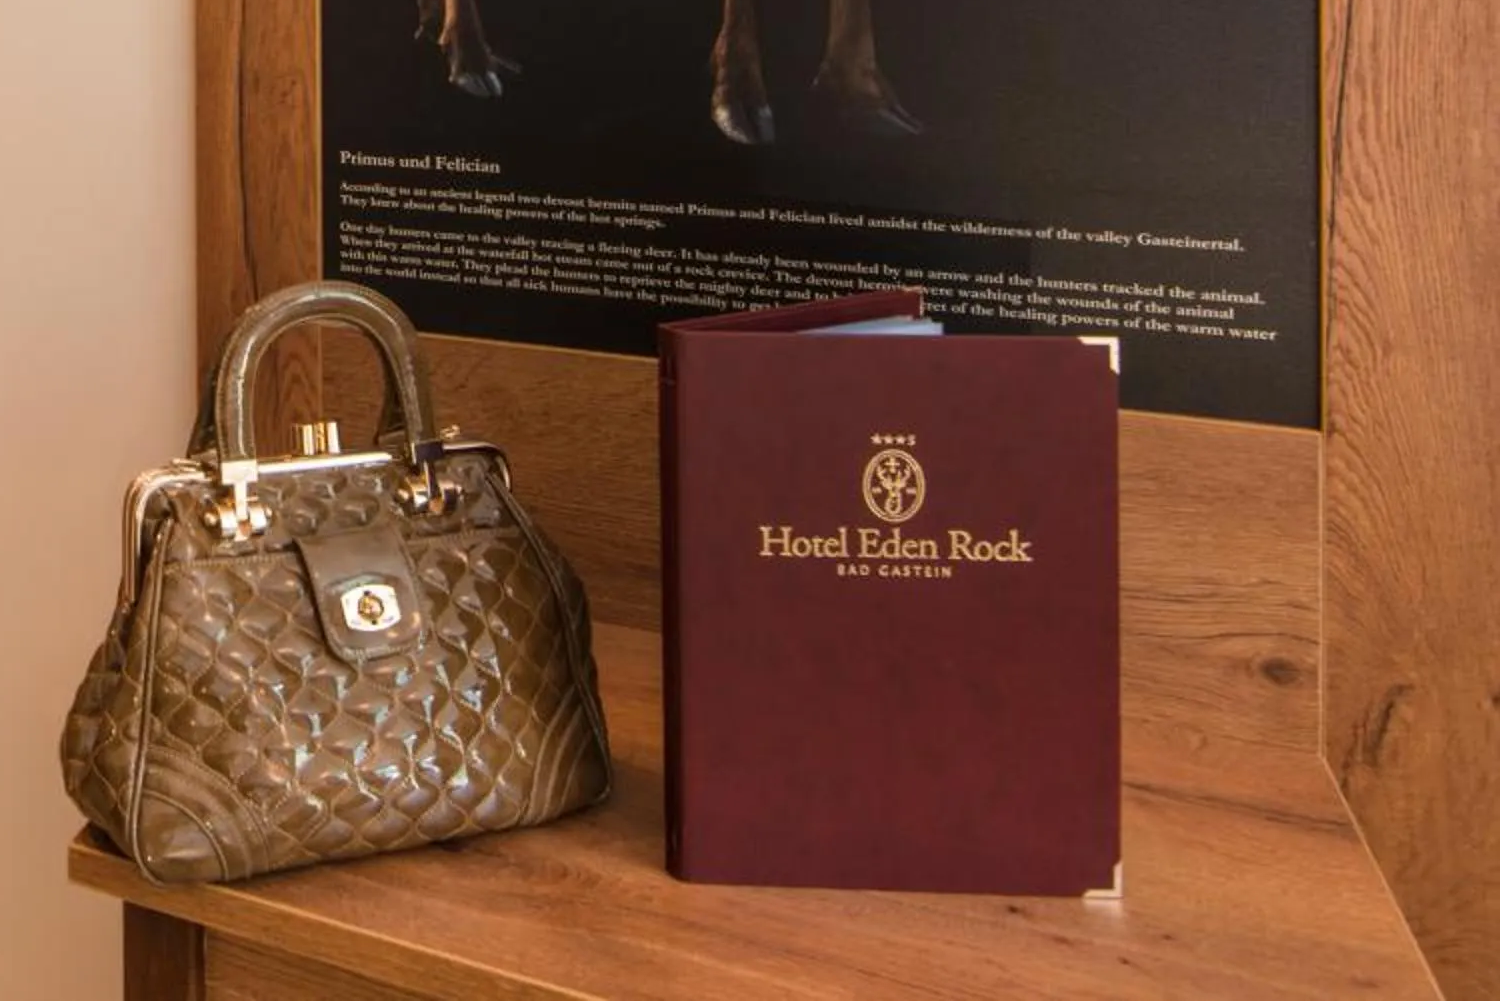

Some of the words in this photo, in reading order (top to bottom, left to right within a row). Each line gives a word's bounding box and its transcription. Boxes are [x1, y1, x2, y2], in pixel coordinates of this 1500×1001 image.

[340, 150, 395, 167] Primus
[399, 155, 430, 169] und
[435, 156, 500, 174] Felician
[340, 180, 396, 197] According
[398, 184, 410, 195] to
[413, 188, 427, 197] an
[429, 188, 472, 200] ancient
[474, 189, 515, 204] legend
[517, 192, 540, 205] two
[542, 194, 584, 208] devout
[587, 197, 636, 211] hermits
[639, 203, 684, 214] named
[688, 204, 736, 218] Primus
[739, 209, 765, 220] and
[769, 210, 825, 224] Felician
[829, 214, 863, 226] lived
[867, 218, 918, 230] amidst
[922, 220, 946, 232] the
[950, 222, 1032, 237] wilderness
[1035, 228, 1051, 239] of
[1056, 228, 1081, 241] the
[1086, 232, 1130, 247] valley
[1136, 234, 1244, 252] Gasteinertal.
[342, 194, 367, 209] They
[370, 196, 399, 208] knew
[403, 199, 435, 211] about
[437, 201, 456, 213] the
[459, 203, 502, 219] healing
[505, 209, 548, 220] powers
[551, 210, 563, 221] of
[566, 210, 586, 222] the
[589, 212, 610, 224] hot
[614, 215, 665, 230] springs.
[774, 256, 809, 269] been
[812, 262, 879, 275] wounded
[883, 265, 900, 279] by
[905, 269, 924, 278] an
[927, 271, 969, 282] arrow
[975, 273, 1004, 284] and
[1008, 274, 1033, 287] the
[1037, 277, 1098, 292] hunters
[1102, 282, 1164, 297] tracked
[1168, 287, 1195, 300] the
[1200, 291, 1264, 305] animal.
[776, 271, 801, 284] The
[805, 274, 853, 288] devout
[958, 290, 1022, 305] washing
[1026, 293, 1051, 305] the
[1056, 298, 1119, 310] wounds
[1123, 301, 1139, 312] of
[1144, 302, 1170, 315] the
[1176, 306, 1234, 320] animal
[750, 284, 780, 297] deer
[784, 289, 811, 300] and
[950, 303, 966, 314] of
[970, 304, 994, 316] the
[999, 307, 1057, 324] healing
[1061, 315, 1119, 327] powers
[1123, 318, 1139, 329] of
[1144, 319, 1171, 331] the
[1176, 325, 1224, 336] warm
[1228, 328, 1275, 341] water
[759, 526, 849, 558] Hotel
[857, 527, 939, 560] Eden
[948, 529, 1034, 562] Rock
[837, 563, 870, 576] BAD
